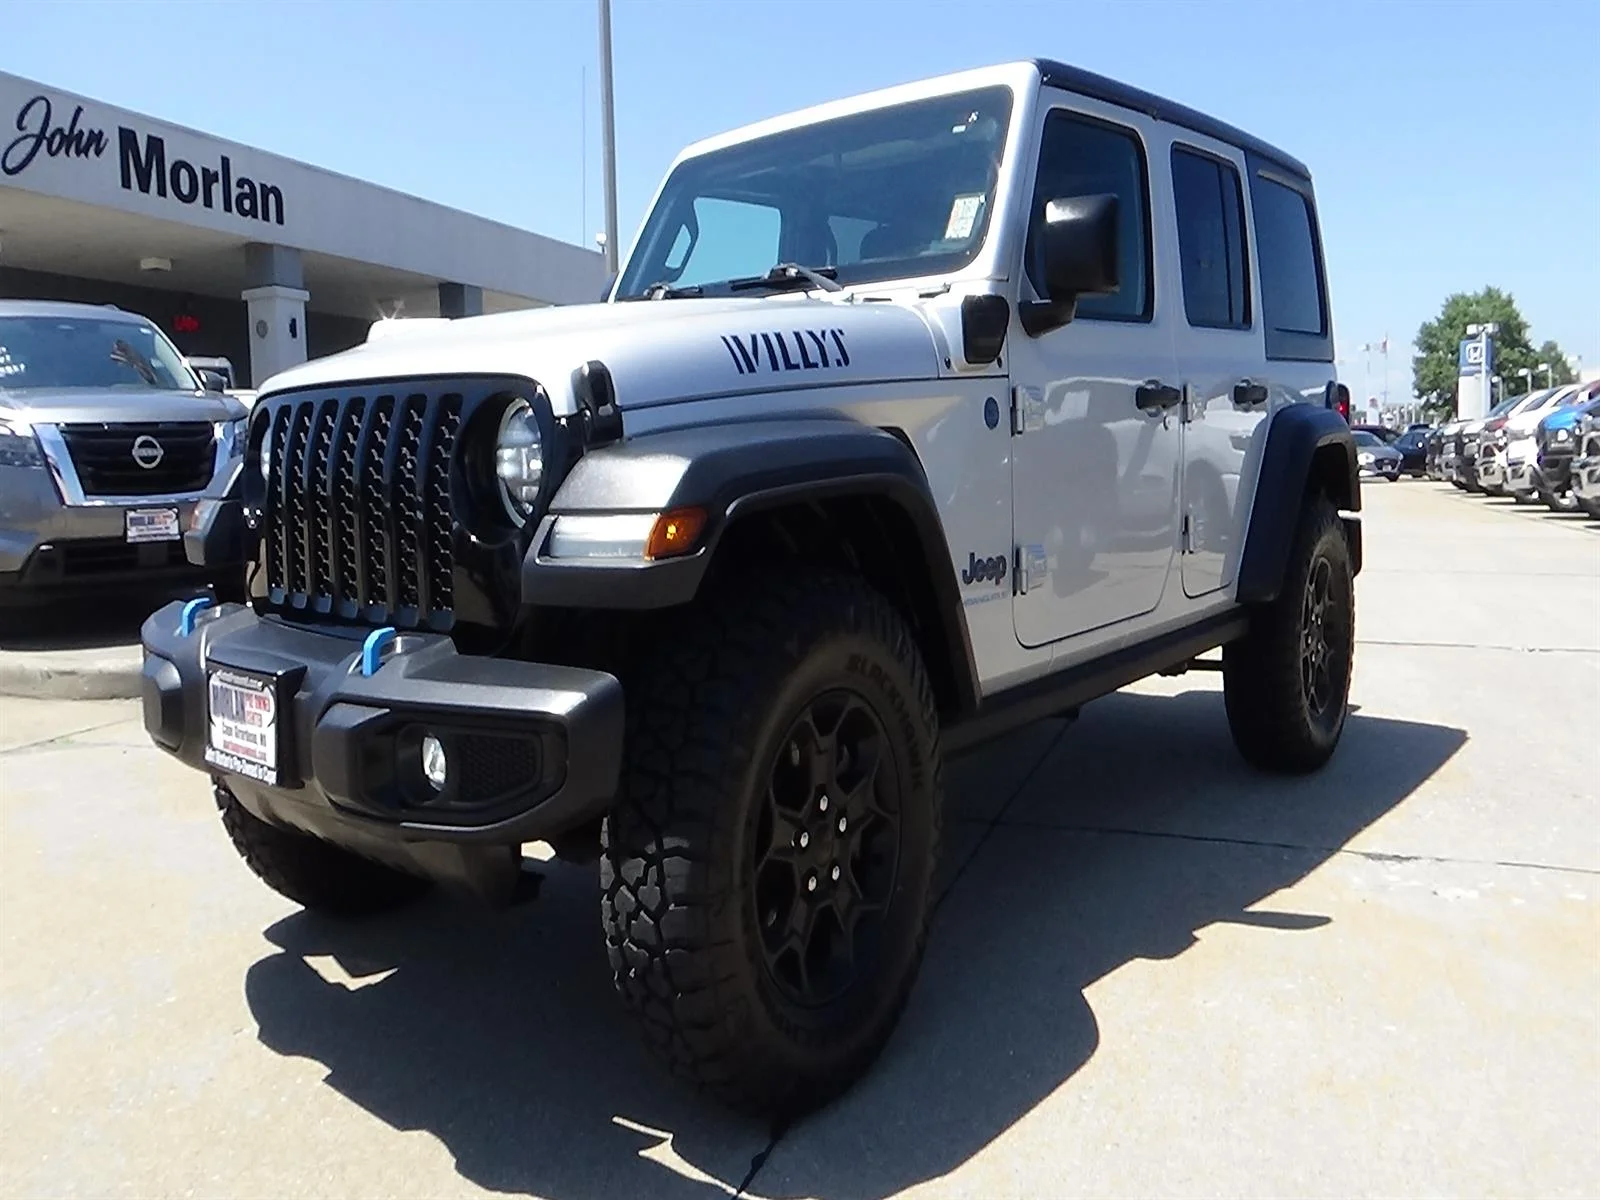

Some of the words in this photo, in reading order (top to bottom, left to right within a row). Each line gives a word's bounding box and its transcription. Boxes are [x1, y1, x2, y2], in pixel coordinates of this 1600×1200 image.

[1, 96, 109, 175] John
[118, 126, 284, 225] Morlan
[720, 328, 850, 375] WILLYS
[962, 552, 1007, 586] Jeep
